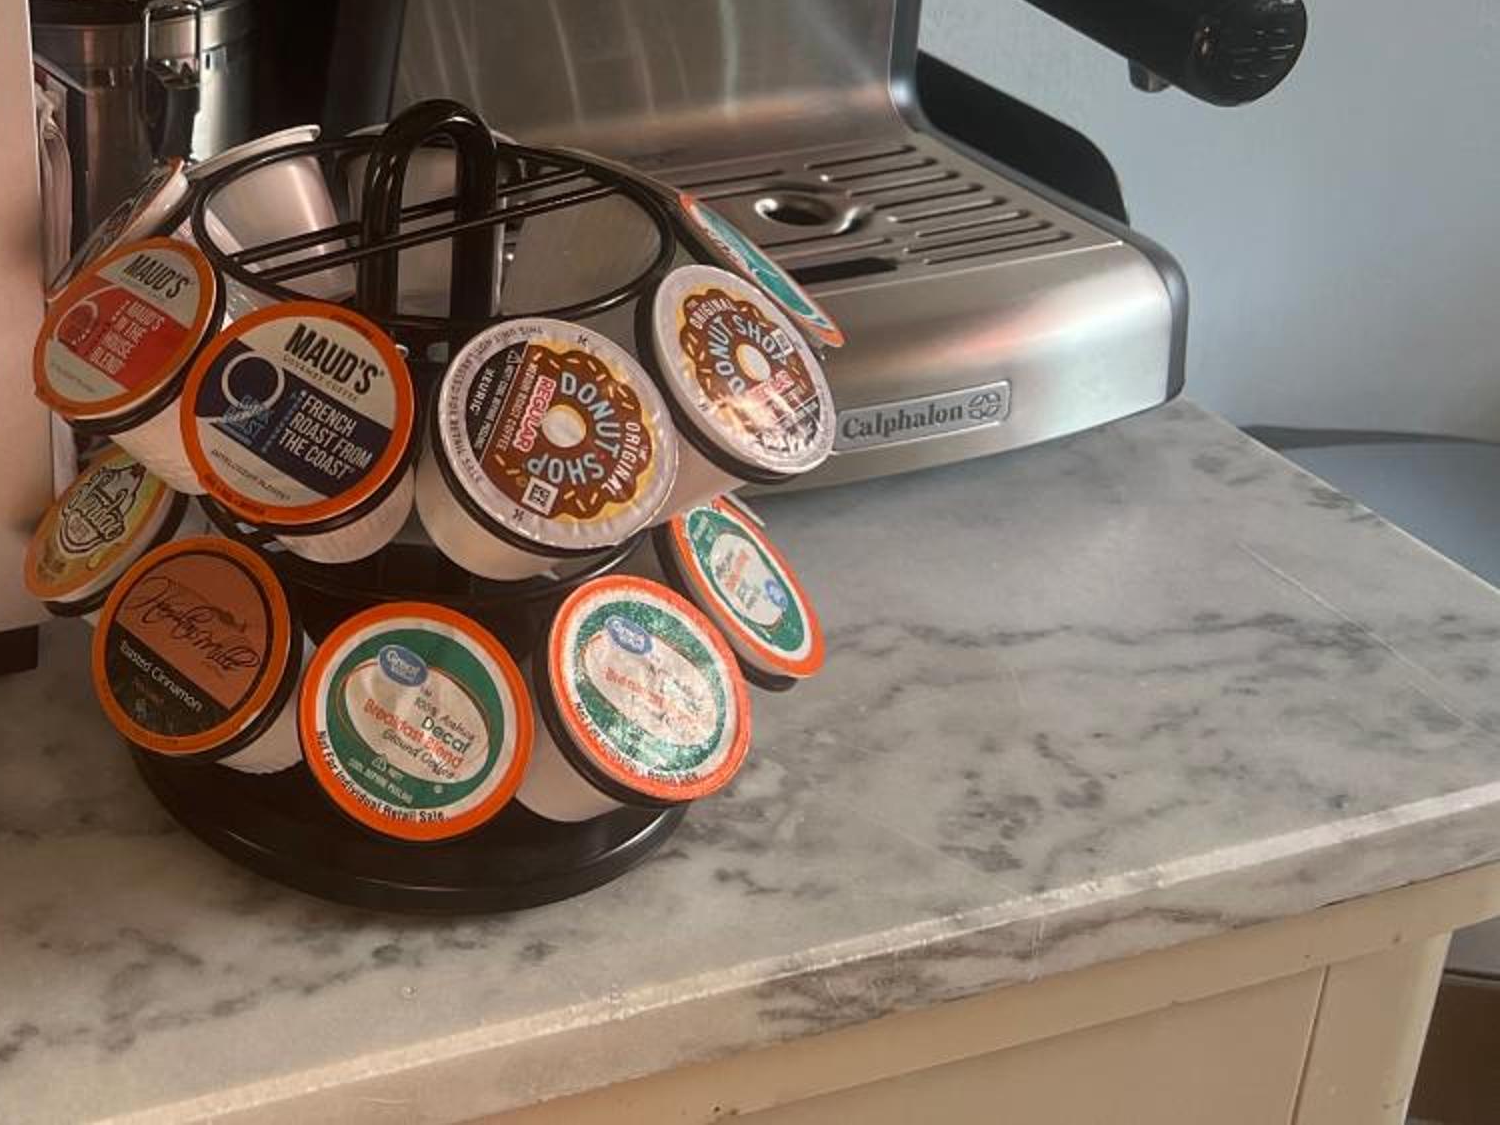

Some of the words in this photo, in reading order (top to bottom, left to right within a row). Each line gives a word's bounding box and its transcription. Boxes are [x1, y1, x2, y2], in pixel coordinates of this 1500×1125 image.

[123, 252, 190, 299] MAUD'S
[689, 298, 738, 329] ORIGINAL
[285, 322, 374, 396] MAUD'S
[708, 315, 746, 396] DONUT
[301, 395, 358, 437] FRENCH
[513, 376, 556, 452] REGULAR
[560, 371, 622, 459] DONUT
[842, 403, 964, 438] Calphalon
[279, 427, 306, 458] THE
[304, 443, 352, 480] COAST
[290, 411, 336, 452] ROAST
[334, 435, 374, 470] FROM
[601, 421, 642, 497] ORIGINAL
[526, 452, 606, 486] SHOP
[151, 665, 204, 713] Cinnamon
[363, 697, 426, 743] Breakfast
[424, 734, 464, 768] Blend
[381, 729, 421, 758] Ground
[421, 716, 472, 755] Decaf
